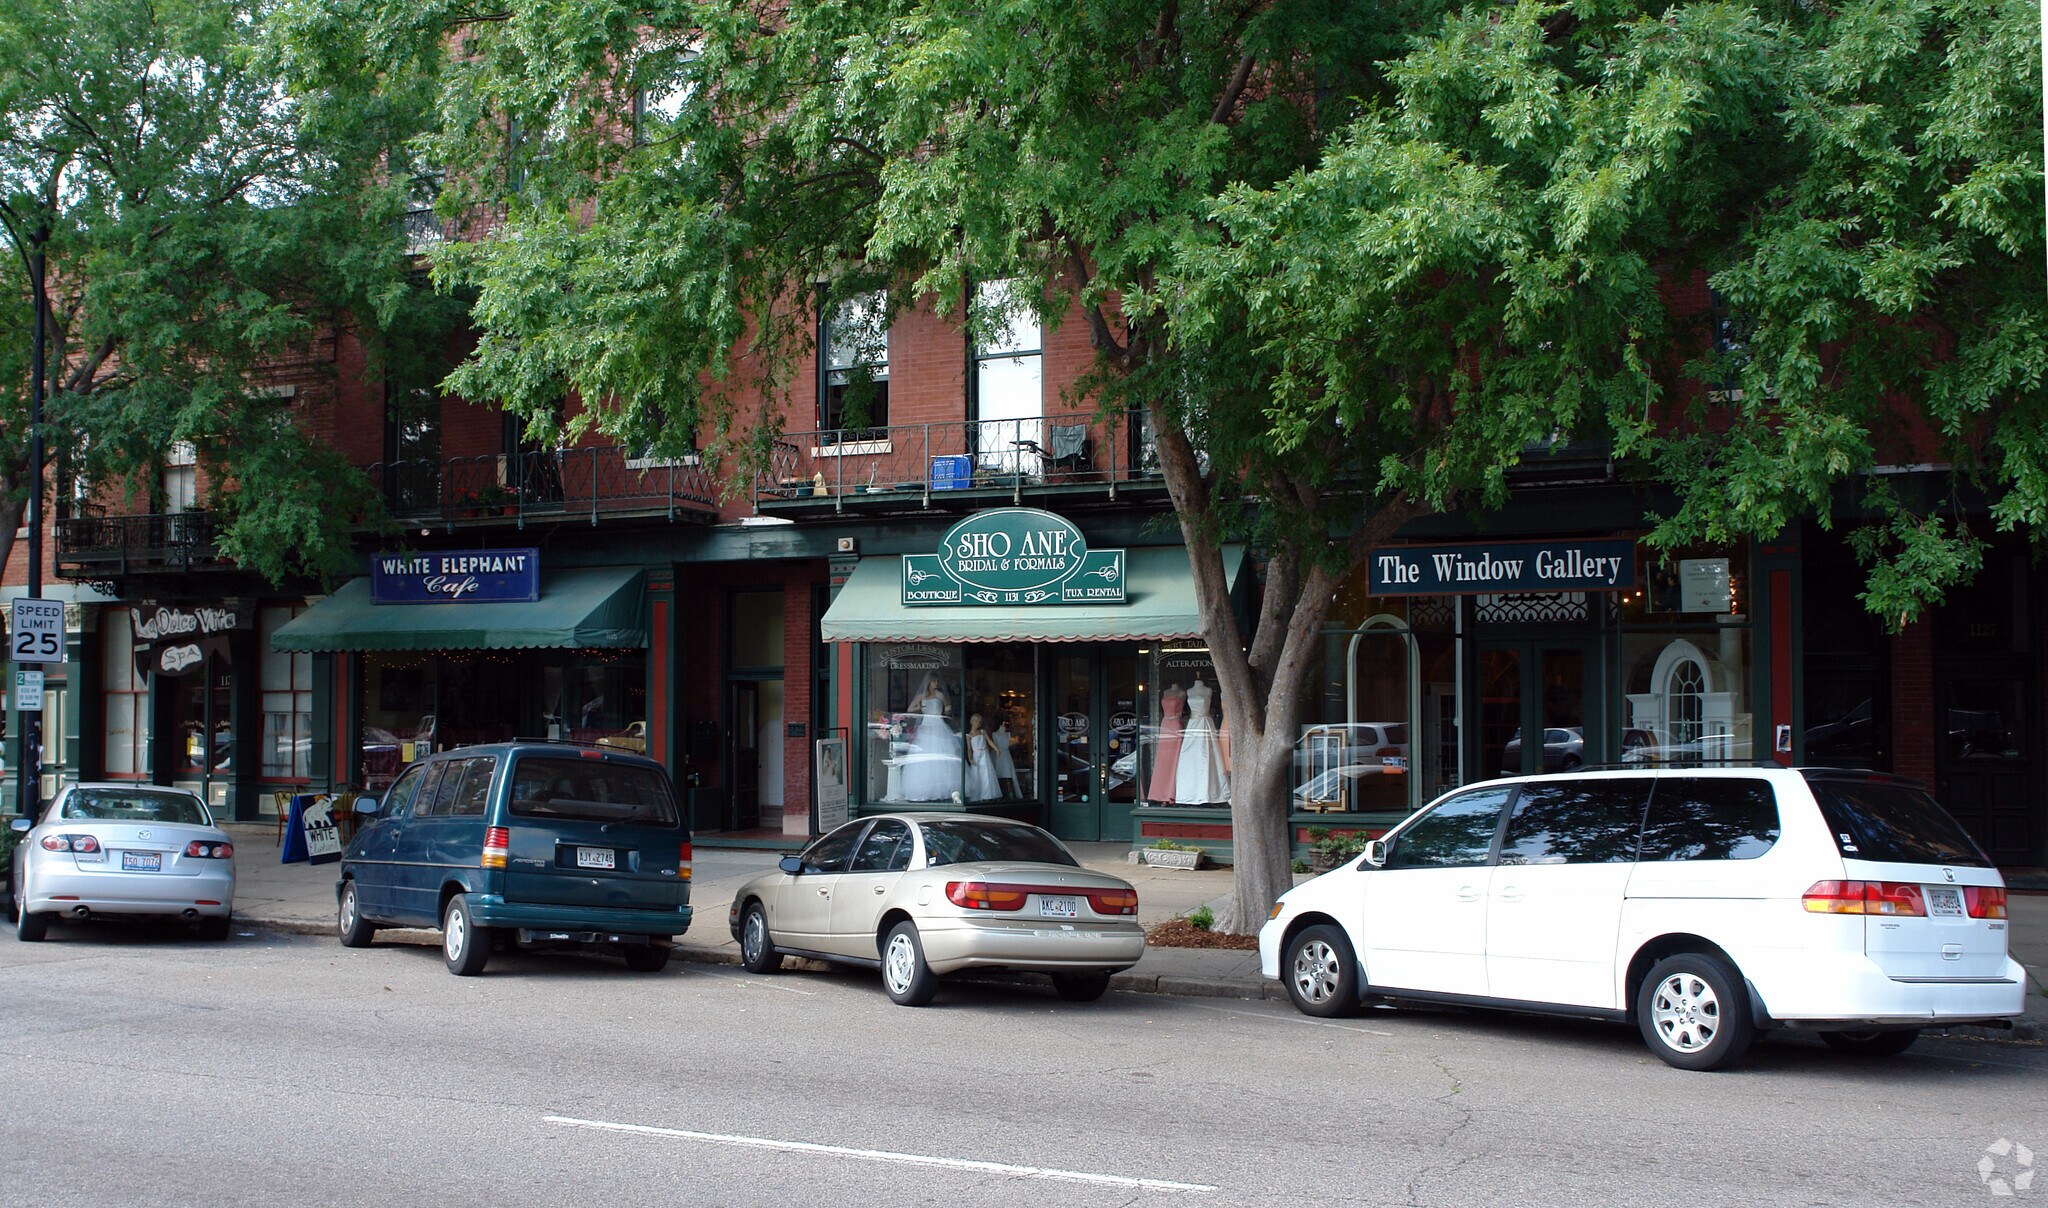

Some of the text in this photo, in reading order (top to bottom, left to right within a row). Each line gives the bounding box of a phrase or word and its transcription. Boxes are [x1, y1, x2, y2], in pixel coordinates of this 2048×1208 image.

[957, 529, 1067, 558] SHO ANE
[382, 556, 526, 575] WHITE ELEPHANT
[958, 558, 1066, 572] BRIDAL & FORMALS
[1378, 550, 1622, 584] The Window Gallery
[422, 576, 479, 598] Cafe
[1066, 588, 1122, 597] TUX RENTAL
[907, 590, 958, 600] BOUTIQUE
[1005, 592, 1019, 602] 1131
[17, 606, 60, 617] SPEED
[22, 620, 54, 629] LIMIT
[131, 607, 236, 638] La Dolce Vita
[16, 632, 58, 654] 25
[880, 644, 950, 660] CUSTOM DESIGNS
[18, 674, 24, 684] 2
[310, 828, 335, 842] WHITE
[1042, 900, 1076, 912] AKC 2100
